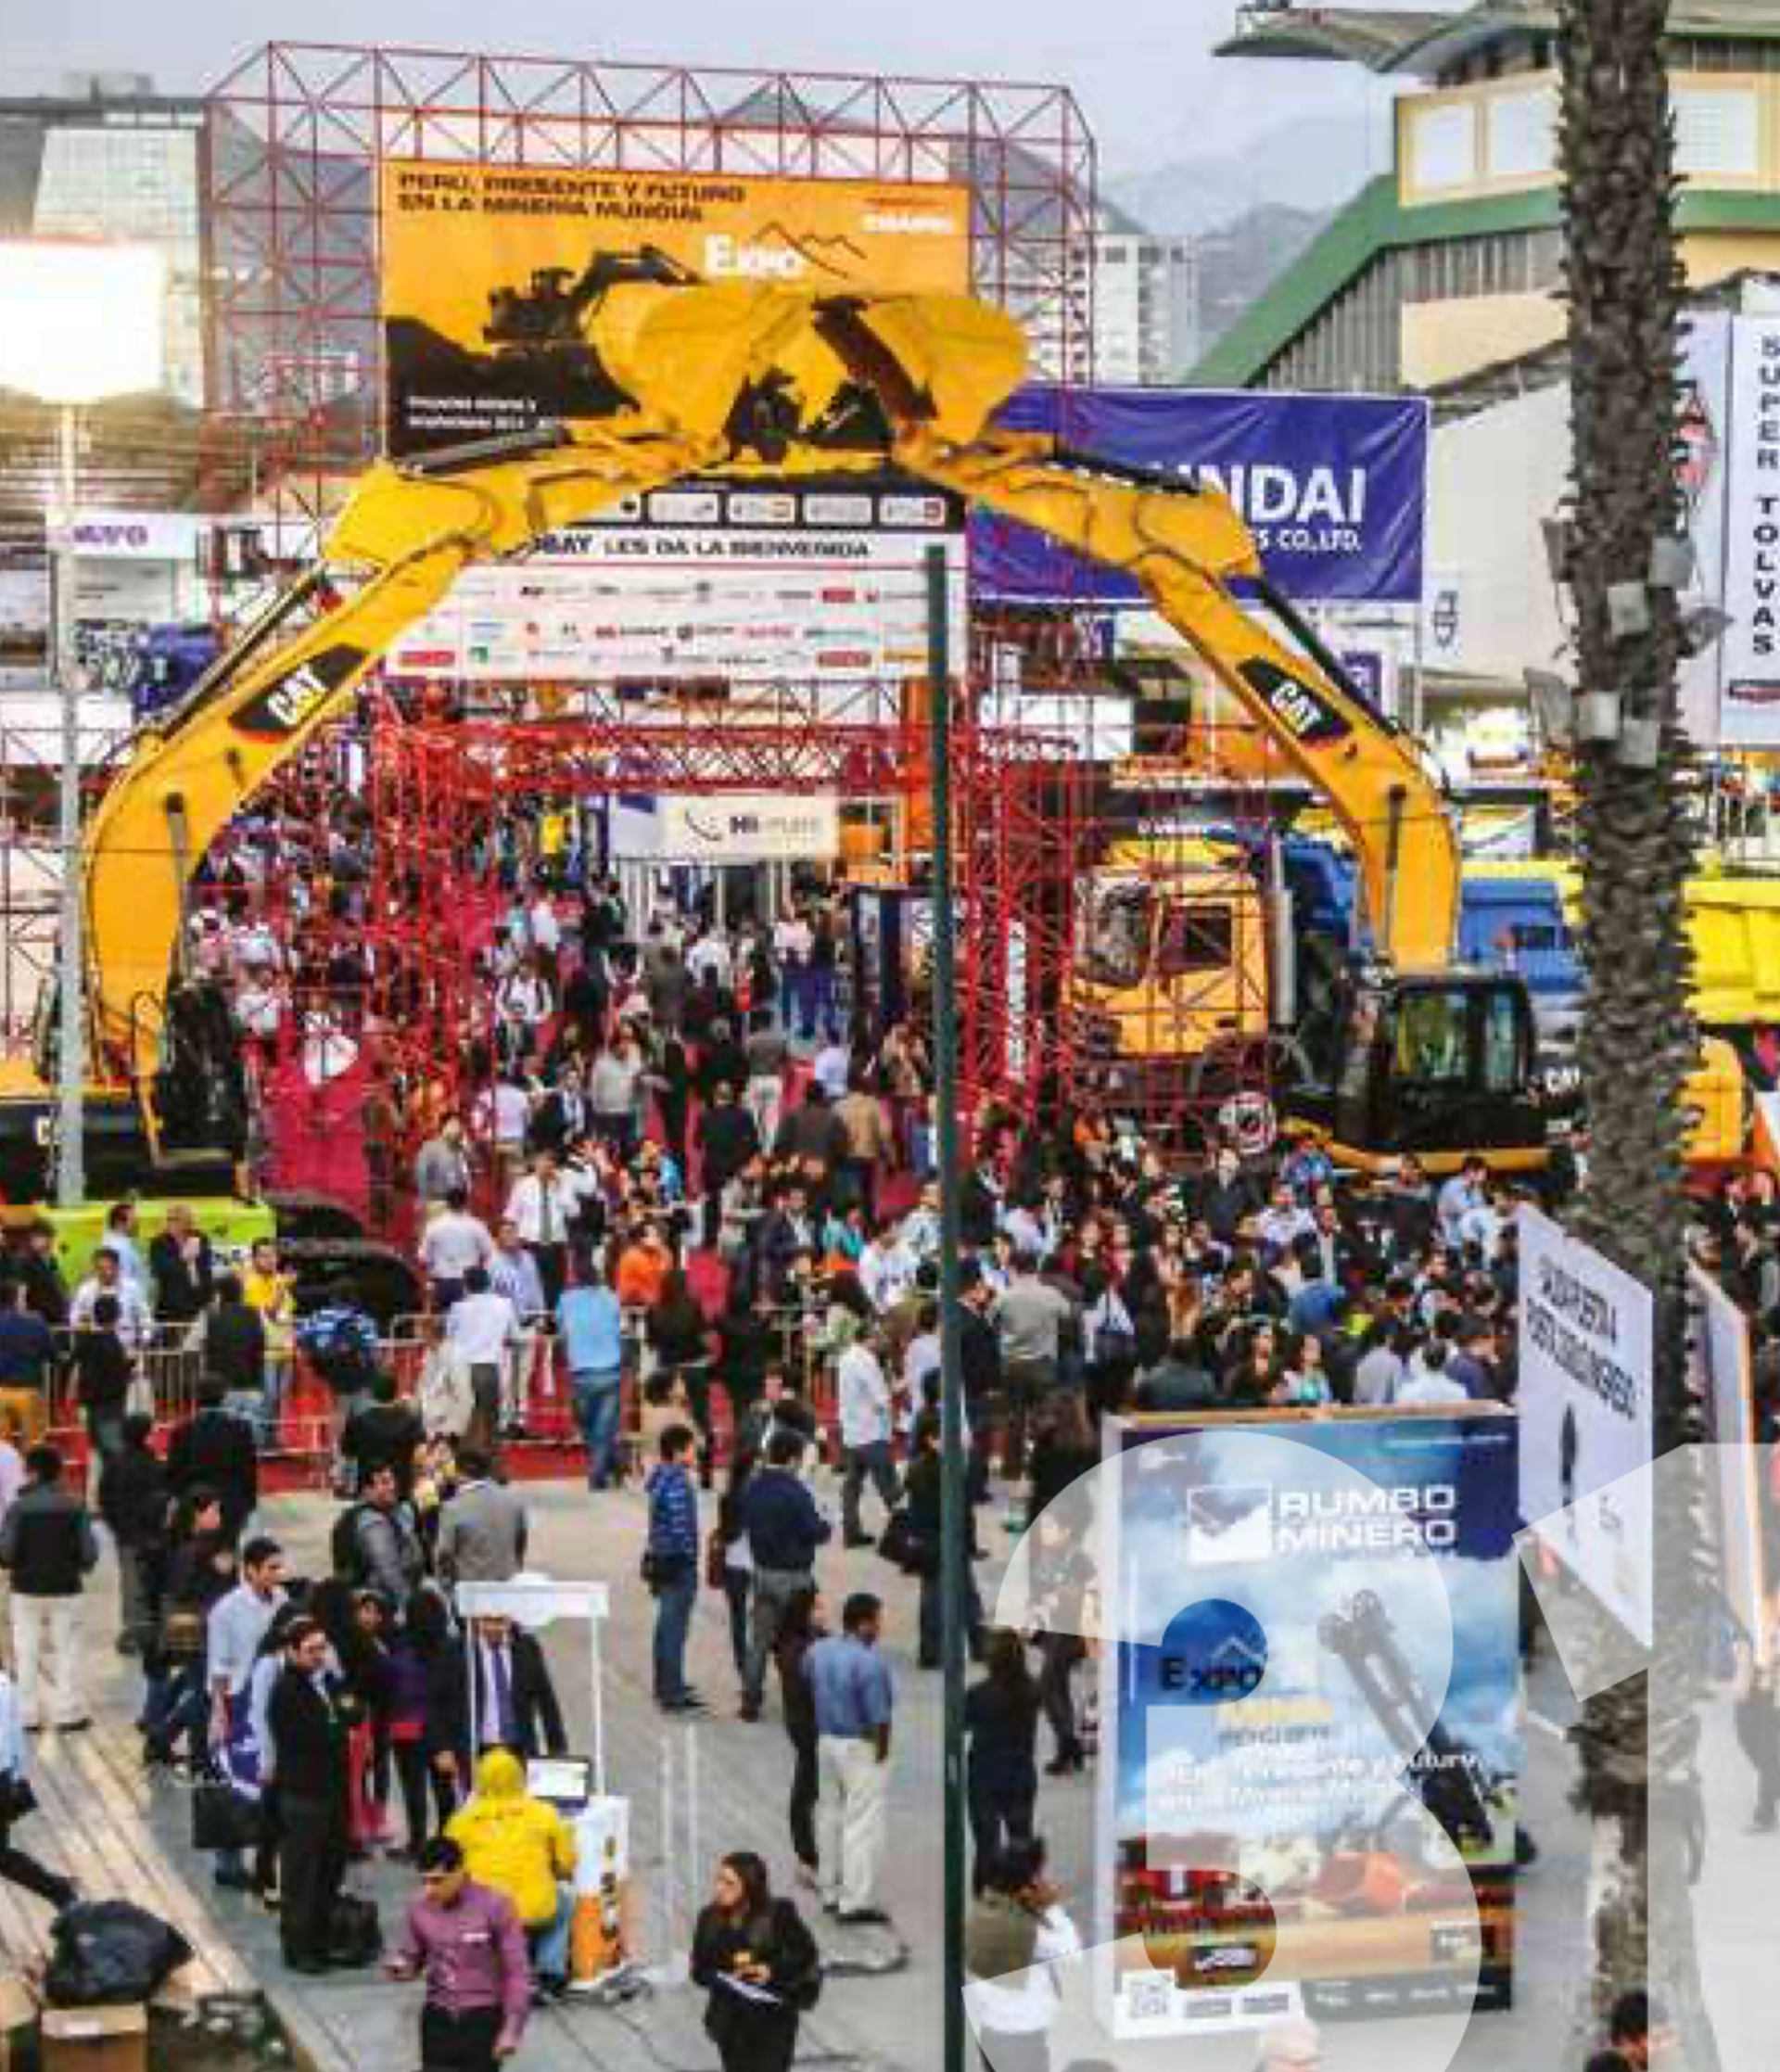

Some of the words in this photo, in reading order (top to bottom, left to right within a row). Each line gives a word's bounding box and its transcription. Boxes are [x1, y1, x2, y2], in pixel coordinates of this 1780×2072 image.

[1752, 496, 1779, 655] TOLVAS
[267, 666, 328, 725] CAT
[1271, 680, 1322, 731] CAT
[1278, 1487, 1456, 1518] RUMBO
[1278, 1519, 1456, 1554] MINERO
